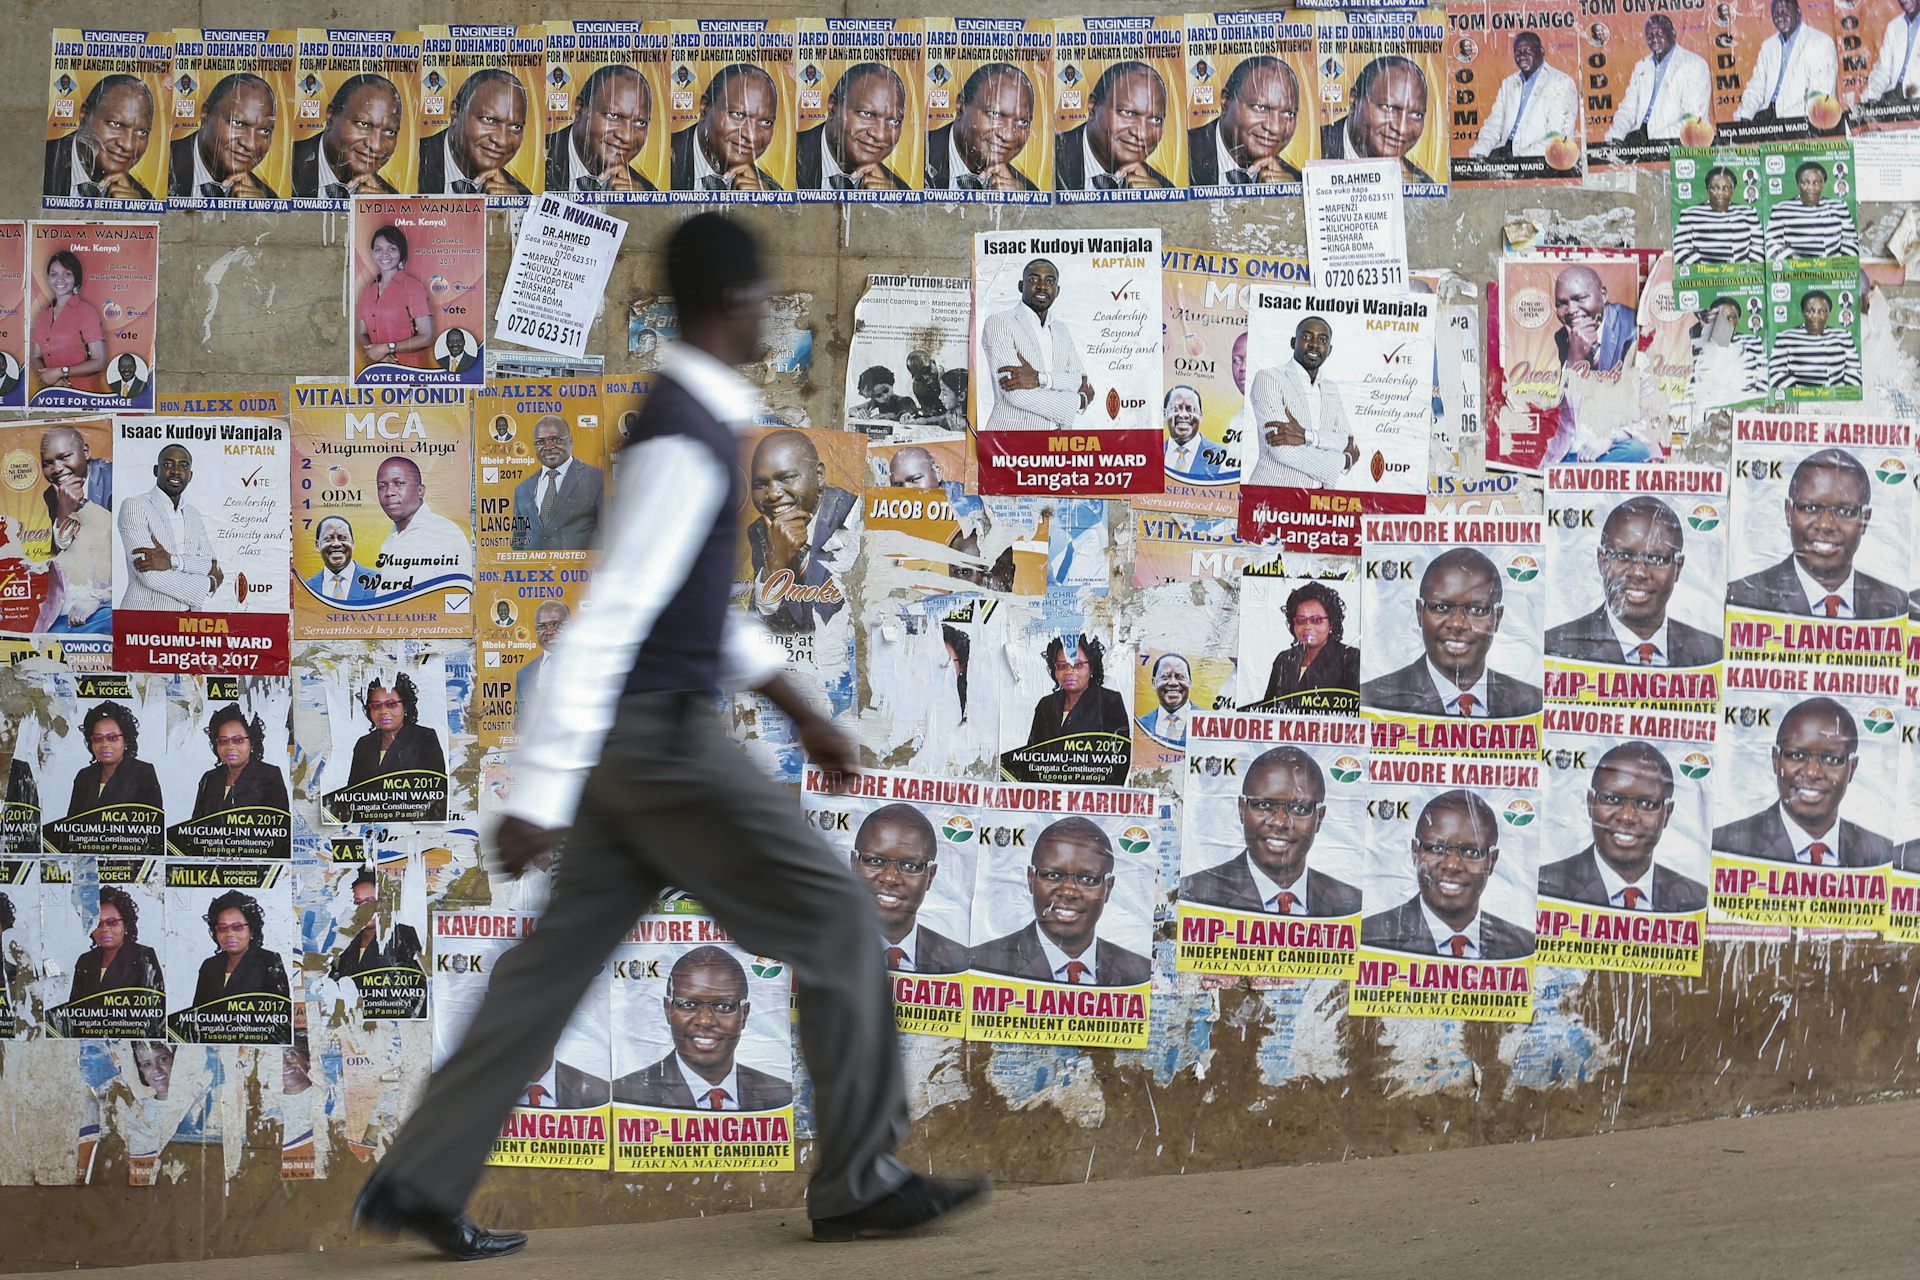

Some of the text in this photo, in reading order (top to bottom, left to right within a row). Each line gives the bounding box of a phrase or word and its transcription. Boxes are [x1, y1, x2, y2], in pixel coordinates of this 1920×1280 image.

[958, 20, 1022, 30] ENGINEER
[1350, 13, 1413, 23] ENGINEER
[1449, 12, 1575, 30] TOM ONYANGO
[85, 31, 145, 42] ENGINEER
[452, 26, 515, 36] ENGINEER
[1409, 25, 1443, 39] OMOLO
[455, 39, 543, 52] ODHIAMBO OMOLO
[926, 32, 1051, 47] JARED ODHIAMBO OMOLO
[55, 43, 172, 59] JARED ODHIAMBO OMOLO
[55, 58, 170, 74] FOR MP LANGATA CONSTITUENCY
[1720, 123, 1808, 137] MCA MUGUMOINI WARD
[1455, 163, 1544, 172] MCA MUGUMOINI WARD
[924, 191, 964, 200] TOWARDS
[975, 192, 1005, 201] BETTER
[46, 198, 85, 208] TOWARDS
[95, 200, 122, 210] BETTER
[360, 204, 481, 213] LYDIA WANJALA
[541, 198, 618, 238] DR. MWANGA
[36, 229, 154, 240] LYDIA M. WANJALA
[70, 244, 120, 252] (Mrs. Kenya)
[542, 239, 557, 248] yuko
[560, 243, 574, 252] hapa
[984, 238, 1152, 255] Isaac Kudoyi Wanjala
[1093, 258, 1145, 269] KAPTAIN
[553, 268, 562, 276] ZA
[563, 271, 586, 283] KIUME
[909, 277, 942, 288] TUTION
[1325, 267, 1401, 287] 0720 623 511
[542, 295, 563, 308] BOMA
[1092, 311, 1147, 324] Leadership
[508, 314, 536, 336] 0720
[538, 322, 558, 341] 623
[561, 329, 581, 347] 511
[1101, 328, 1142, 341] Beyond
[1087, 343, 1157, 357] Ethnicity and
[1109, 361, 1133, 370] Class
[296, 388, 464, 406] VITALIS OMONDI
[502, 384, 597, 397] ALEX OUDA
[39, 398, 132, 406] VOTE FOR CHANGE
[517, 401, 562, 413] OTIENO
[1121, 400, 1145, 408] UDP
[122, 424, 282, 442] Isaac Kudoyi Wanjala
[345, 412, 426, 440] MCA
[1738, 420, 1910, 445] KAVORE KARIUKI
[225, 445, 275, 456] KAPTAIN
[1049, 436, 1100, 452] MCA
[992, 454, 1146, 468] MUGUMU-INI WARD
[500, 470, 522, 479] 2017
[1016, 471, 1133, 490] Langata 2017
[1548, 468, 1722, 492] KAVORE KARIUKI
[322, 489, 361, 501] ODM
[481, 499, 510, 514] MP
[870, 499, 922, 518] JACOB
[480, 517, 531, 532] LANGATA
[1366, 521, 1541, 543] KAVORE KARIUKI
[376, 553, 459, 569] Mugumoini
[359, 575, 414, 591] Ward
[327, 613, 437, 622] SERVANT LEADER
[179, 618, 229, 633] MCA
[377, 626, 396, 635] key
[399, 626, 410, 634] to
[126, 634, 272, 649] MUGUMU-INI WARD
[1730, 622, 1904, 653] MP-LANGATA
[149, 650, 258, 670] Langata 2017
[1191, 717, 1366, 744] KAVORE KARIUKI
[1370, 723, 1537, 750] MP-LANGATA
[1064, 741, 1124, 751] MCA 2017
[983, 787, 1154, 815] KAVORE KARIUKI
[171, 868, 257, 885] MILKA KOECH
[1714, 868, 1887, 900] MP-LANGATA
[1182, 917, 1356, 949] MP-LANGATA
[1181, 947, 1355, 966] INDEPENDENT CANDIDATE
[1355, 961, 1529, 992] MP-LANGATA
[972, 988, 1146, 1019] MP-LANGATA
[1354, 989, 1528, 1007] INDEPENDENT CANDIDATE
[228, 1001, 285, 1012] MCA 2017
[179, 1013, 288, 1023] MUGUMU-INI WARD
[971, 1014, 1144, 1034] INDEPENDENT CANDIDATE
[619, 1116, 790, 1143] MP-LANGATA
[619, 1146, 790, 1157] INDEPENDENT CANDIDATE
[631, 1159, 778, 1169] HAKI NA MAENDELEO
